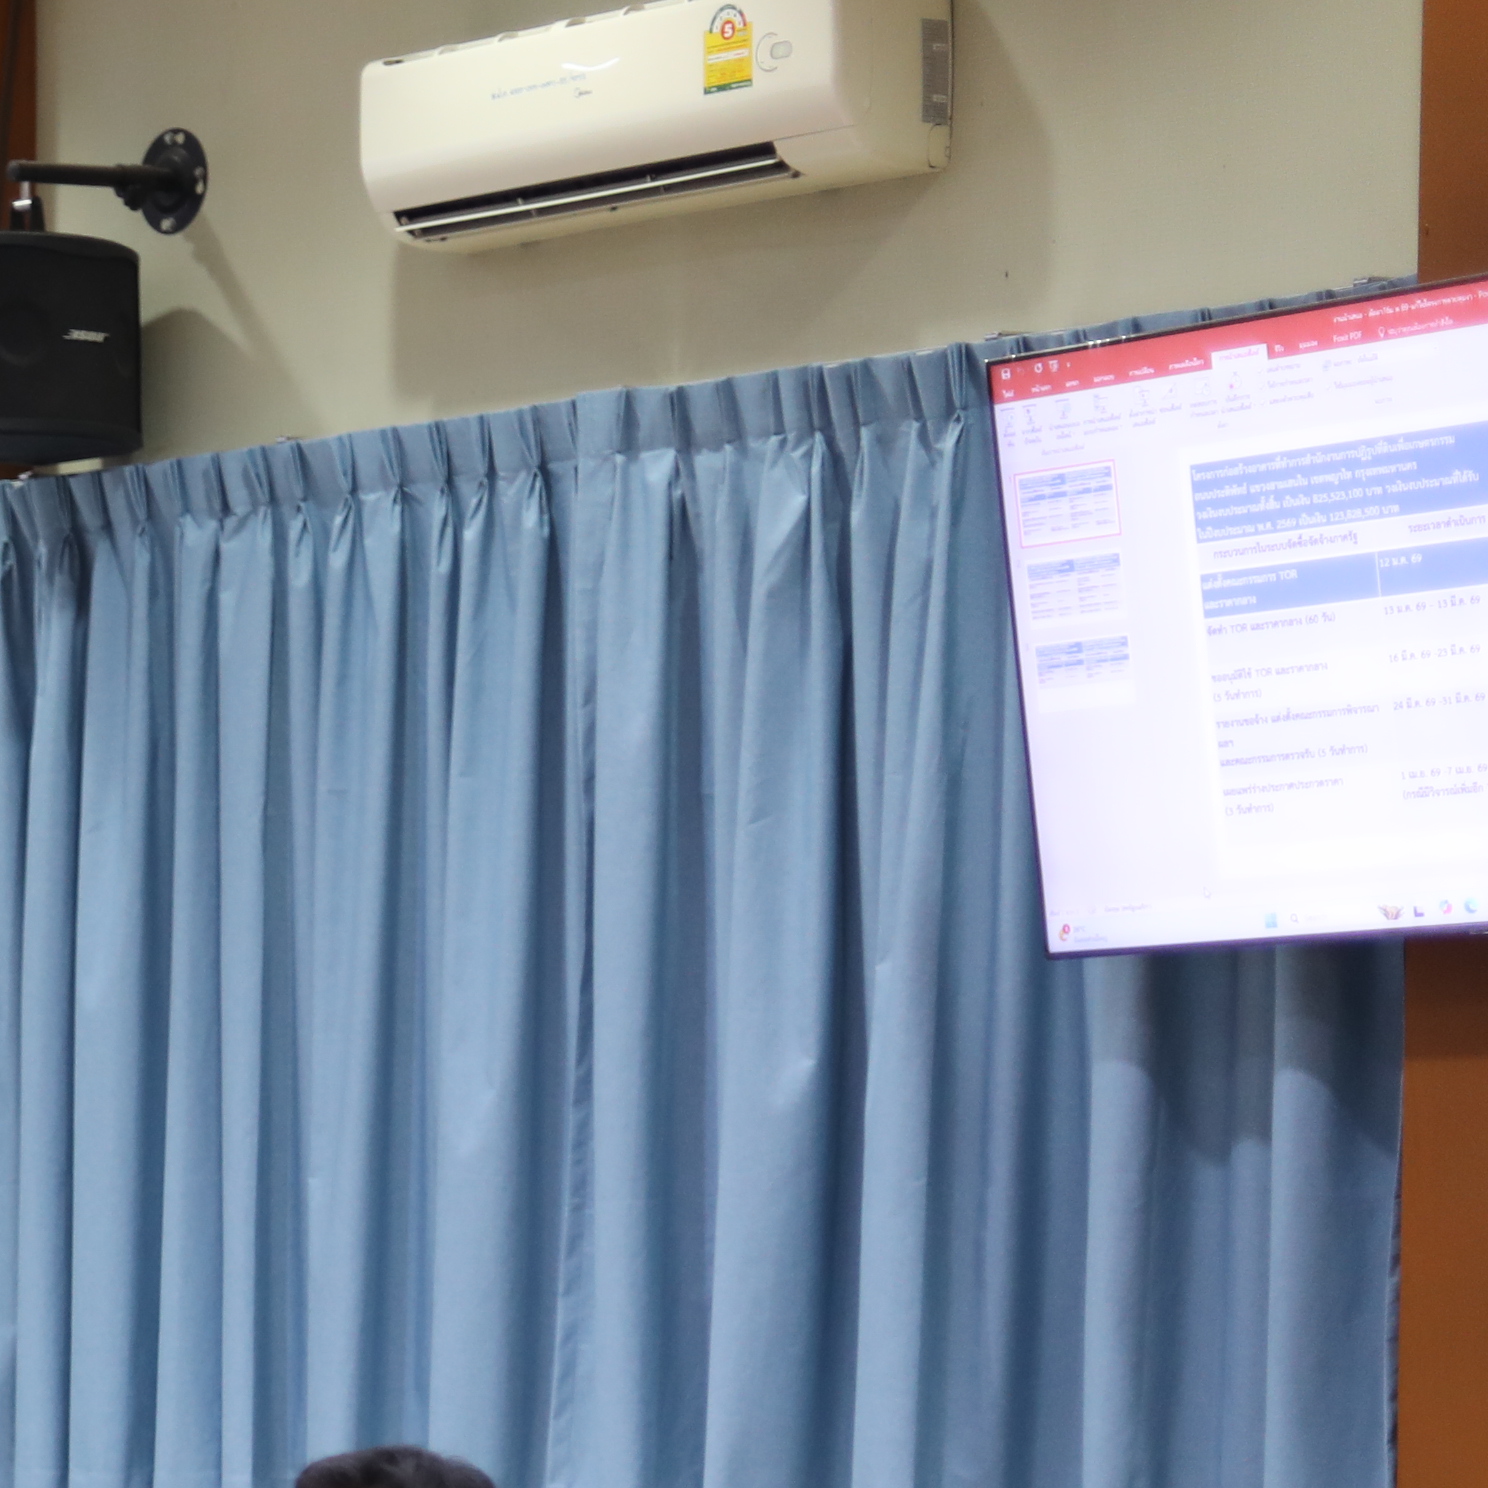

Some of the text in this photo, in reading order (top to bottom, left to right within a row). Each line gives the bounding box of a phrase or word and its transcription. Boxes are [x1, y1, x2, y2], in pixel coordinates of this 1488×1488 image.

[723, 22, 734, 38] 5
[1333, 333, 1349, 344] Foxit
[1350, 330, 1362, 341] PDF
[1355, 460, 1417, 480] กรุงเทพมหานคร
[1366, 485, 1384, 497] บาท
[1276, 517, 1297, 530] 2569
[1382, 504, 1400, 515] บาท
[1213, 513, 1486, 560] กระบวนการในระบบจัดซื้อจัดจ้างภาครัฐ ระยะเวลาดำเนินการ
[1379, 557, 1390, 568] 12
[1410, 553, 1422, 564] 69
[1278, 568, 1298, 582] TOR
[1203, 594, 1257, 611] และราคากลาง
[1384, 605, 1395, 616] 13
[1416, 600, 1427, 612] 69
[1437, 599, 1448, 610] 13
[1470, 594, 1481, 606] 69
[1207, 611, 1337, 637] จัดทำ TOR และราคากลาง (60 วัน)
[1389, 653, 1399, 664] 16
[1420, 649, 1432, 660] 69
[1470, 643, 1481, 655] 69
[1255, 666, 1273, 679] TOR
[1275, 661, 1329, 677] และราคากลาง
[1224, 687, 1263, 702] วันทำการ)
[1425, 697, 1436, 708] 69
[1475, 691, 1487, 703] 69
[1216, 703, 1381, 730] รายงานขอจ้าง แต่งตั้งคณะกรรมการพิจารณา
[1219, 749, 1316, 768] และคณะกรรมการตรวจรับ
[1329, 743, 1369, 758] วันทำการ)
[1430, 767, 1441, 778] 69
[1477, 763, 1488, 774] 69
[1223, 776, 1344, 797] เผยแพร่ร่างประกาศประกวดราคา
[1236, 802, 1275, 816] วันทำการ)
